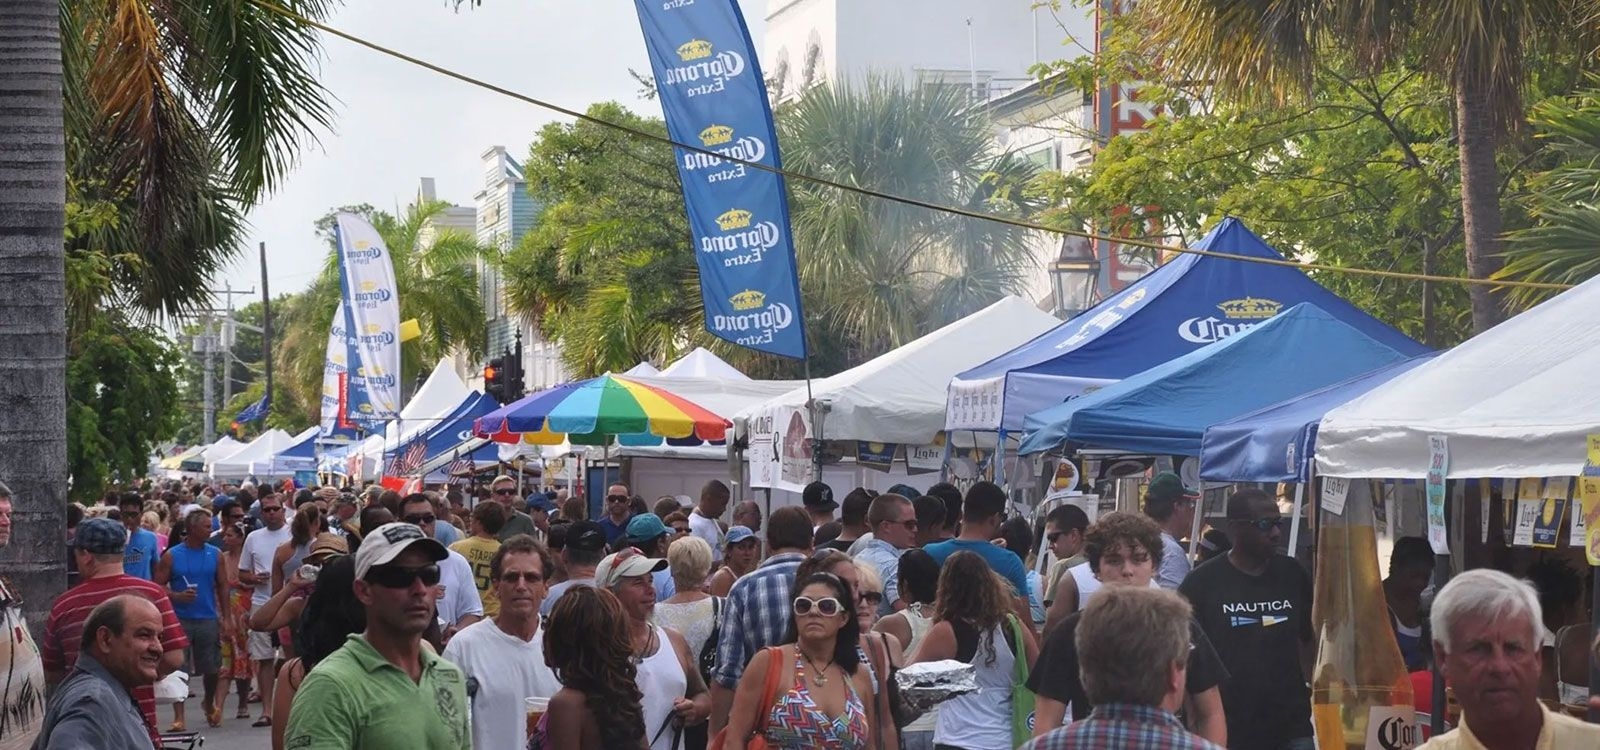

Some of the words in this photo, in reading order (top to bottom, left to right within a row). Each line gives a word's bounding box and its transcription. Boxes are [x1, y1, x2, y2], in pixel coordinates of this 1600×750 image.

[914, 446, 939, 459] Light
[1325, 476, 1344, 496] Light
[1222, 600, 1292, 613] NAUTICA
